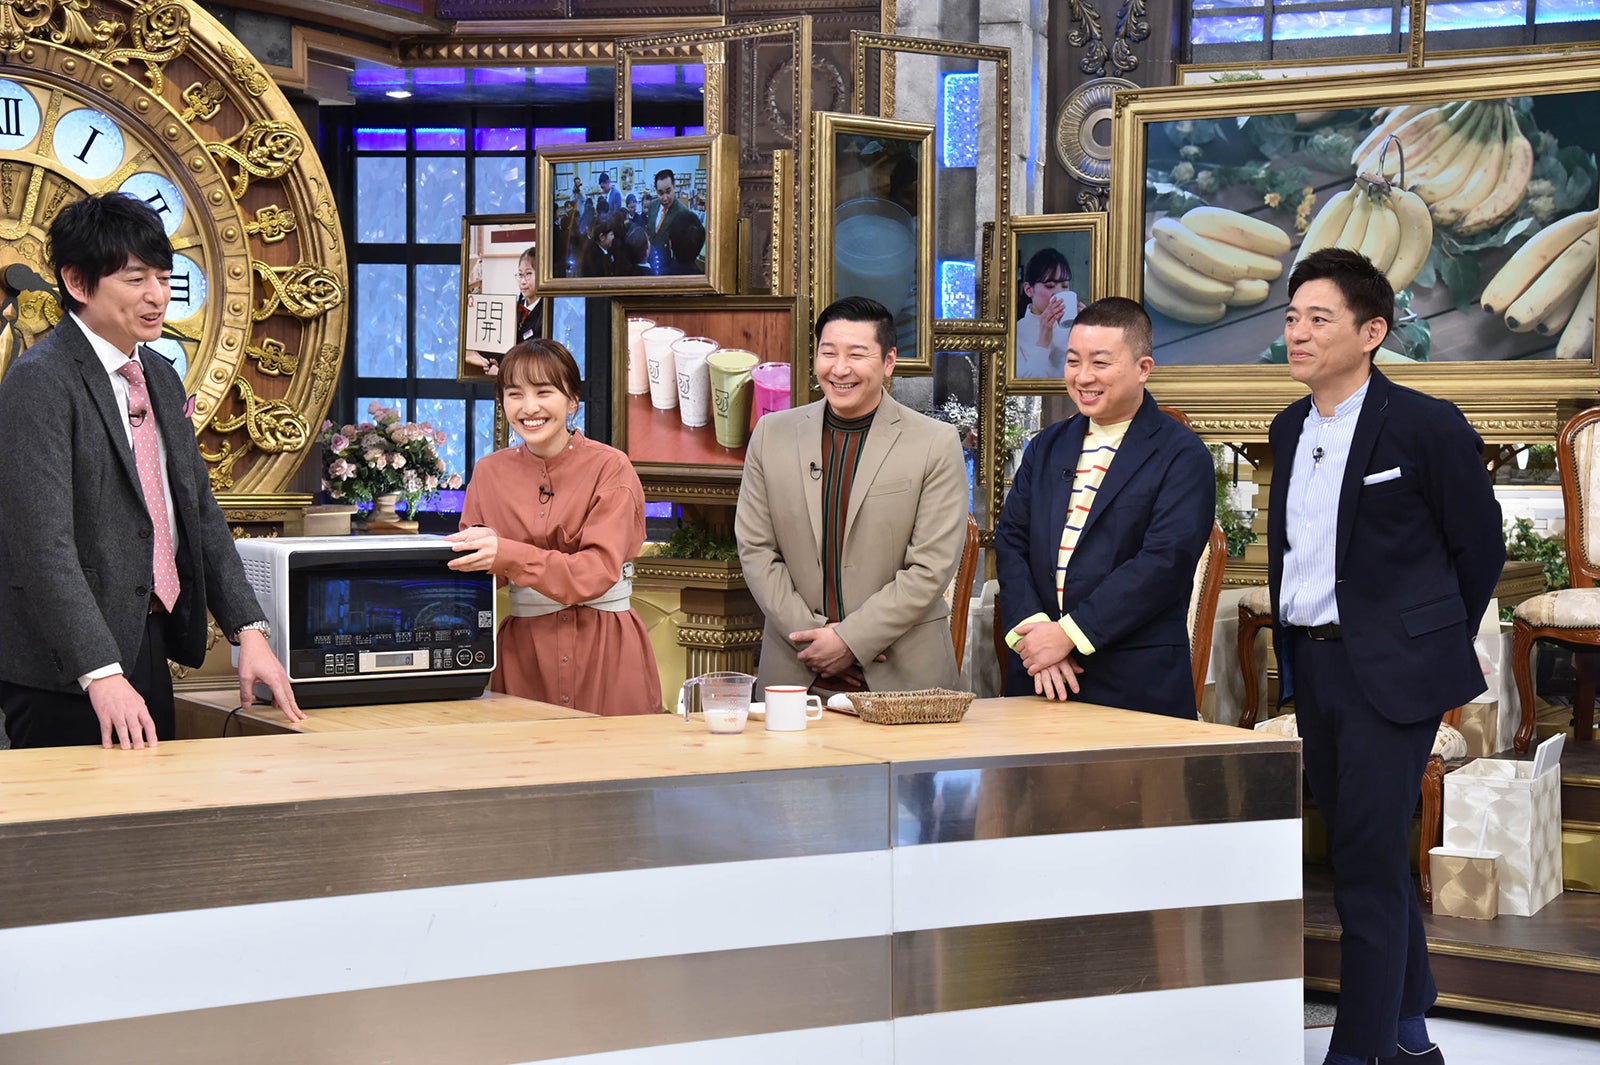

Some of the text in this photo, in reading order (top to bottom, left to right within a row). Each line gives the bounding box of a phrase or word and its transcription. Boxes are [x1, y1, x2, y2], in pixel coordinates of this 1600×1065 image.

[0, 96, 25, 136] II
[73, 124, 104, 165] I
[475, 301, 503, 344] 開
